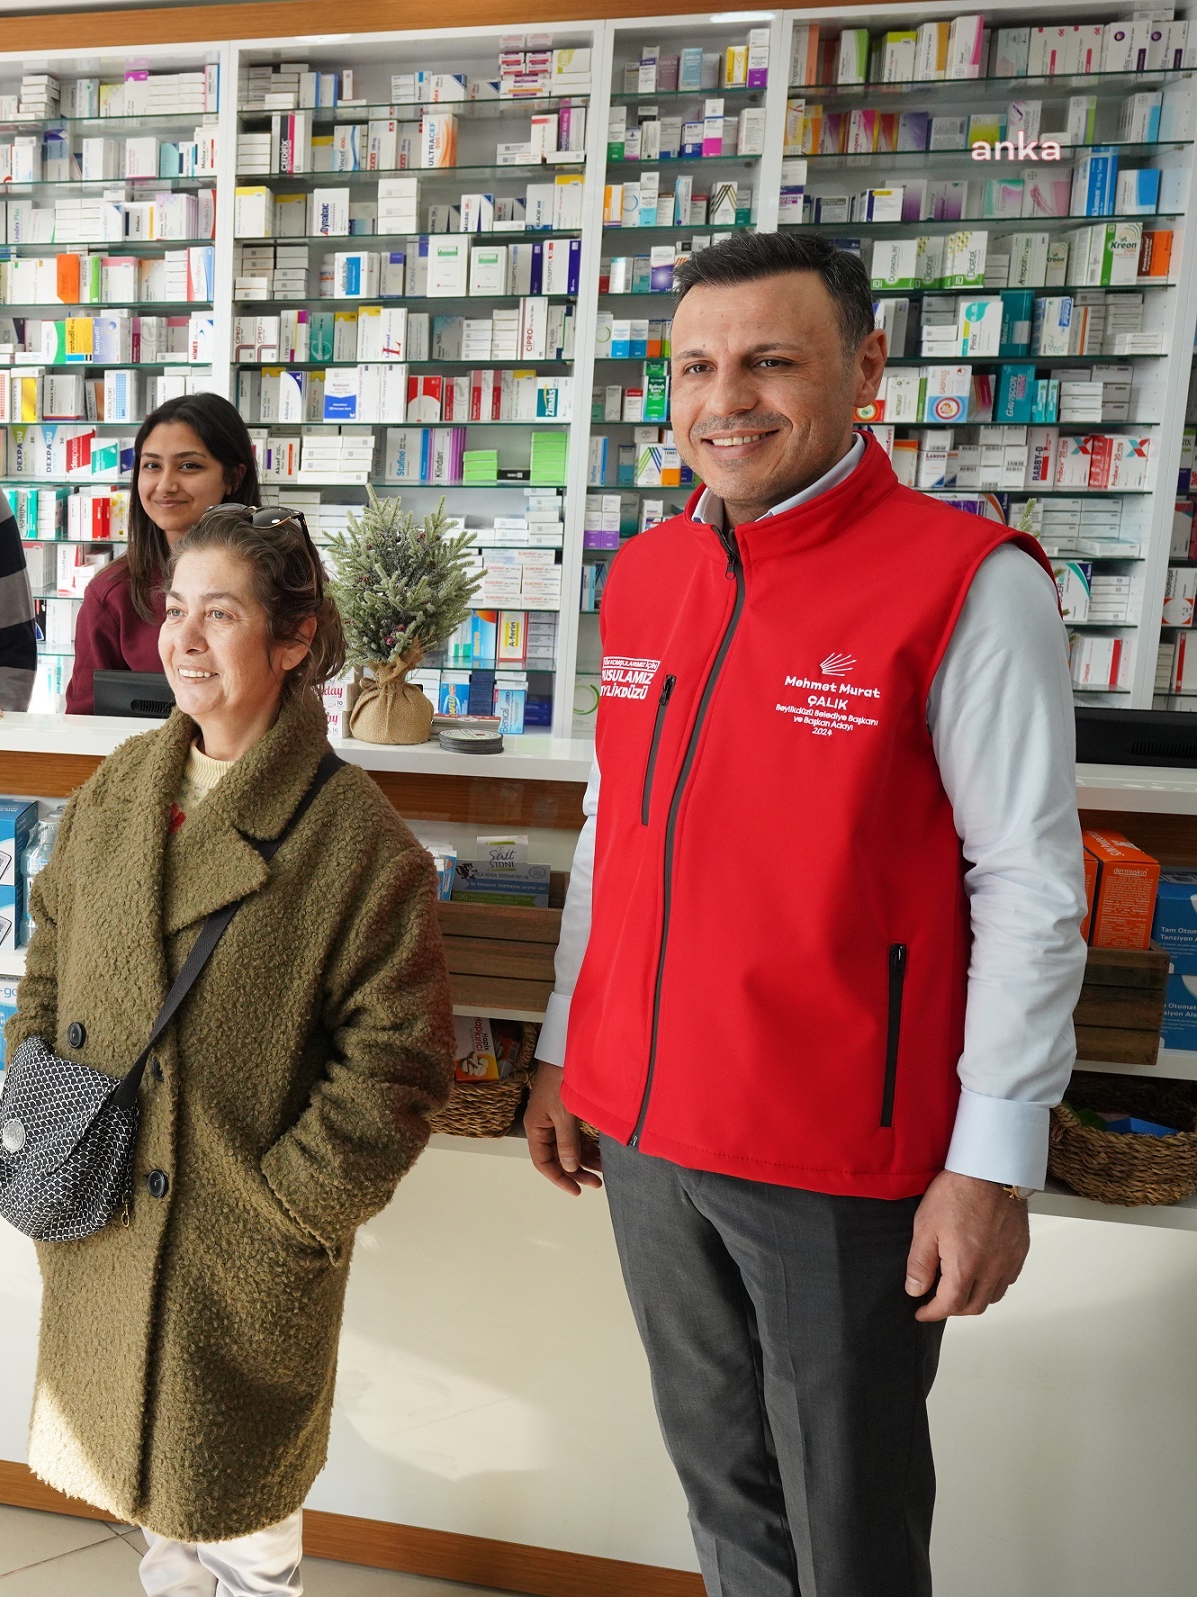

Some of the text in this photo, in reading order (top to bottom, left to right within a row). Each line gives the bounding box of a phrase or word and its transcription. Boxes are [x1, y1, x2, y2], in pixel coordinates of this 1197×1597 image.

[428, 122, 436, 166] ULTRACEF
[320, 203, 329, 234] Dynabac
[1110, 241, 1137, 249] Kreon
[67, 330, 75, 354] rantudil
[545, 389, 555, 416] Zimaks
[1006, 376, 1017, 416] GAVISCON
[1059, 450, 1065, 459] 20
[1061, 440, 1068, 450] mg
[396, 450, 405, 477] Stafine
[435, 452, 443, 478] Klindan
[1032, 446, 1043, 481] RABBY-D
[1111, 442, 1123, 487] Probex 20 mg
[600, 682, 649, 700] YLİKDÜZÜ
[784, 675, 880, 698] Mehmet Murat
[807, 695, 849, 710] ÇALIK
[775, 703, 879, 726] Beylikdüzü Belediye Başkanı
[804, 716, 831, 728] Başkan
[831, 720, 854, 731] Adayı
[812, 727, 833, 737] 2024
[489, 848, 516, 861] Salt
[1113, 868, 1147, 876] dermoskin
[1160, 934, 1193, 942] Tansiyon
